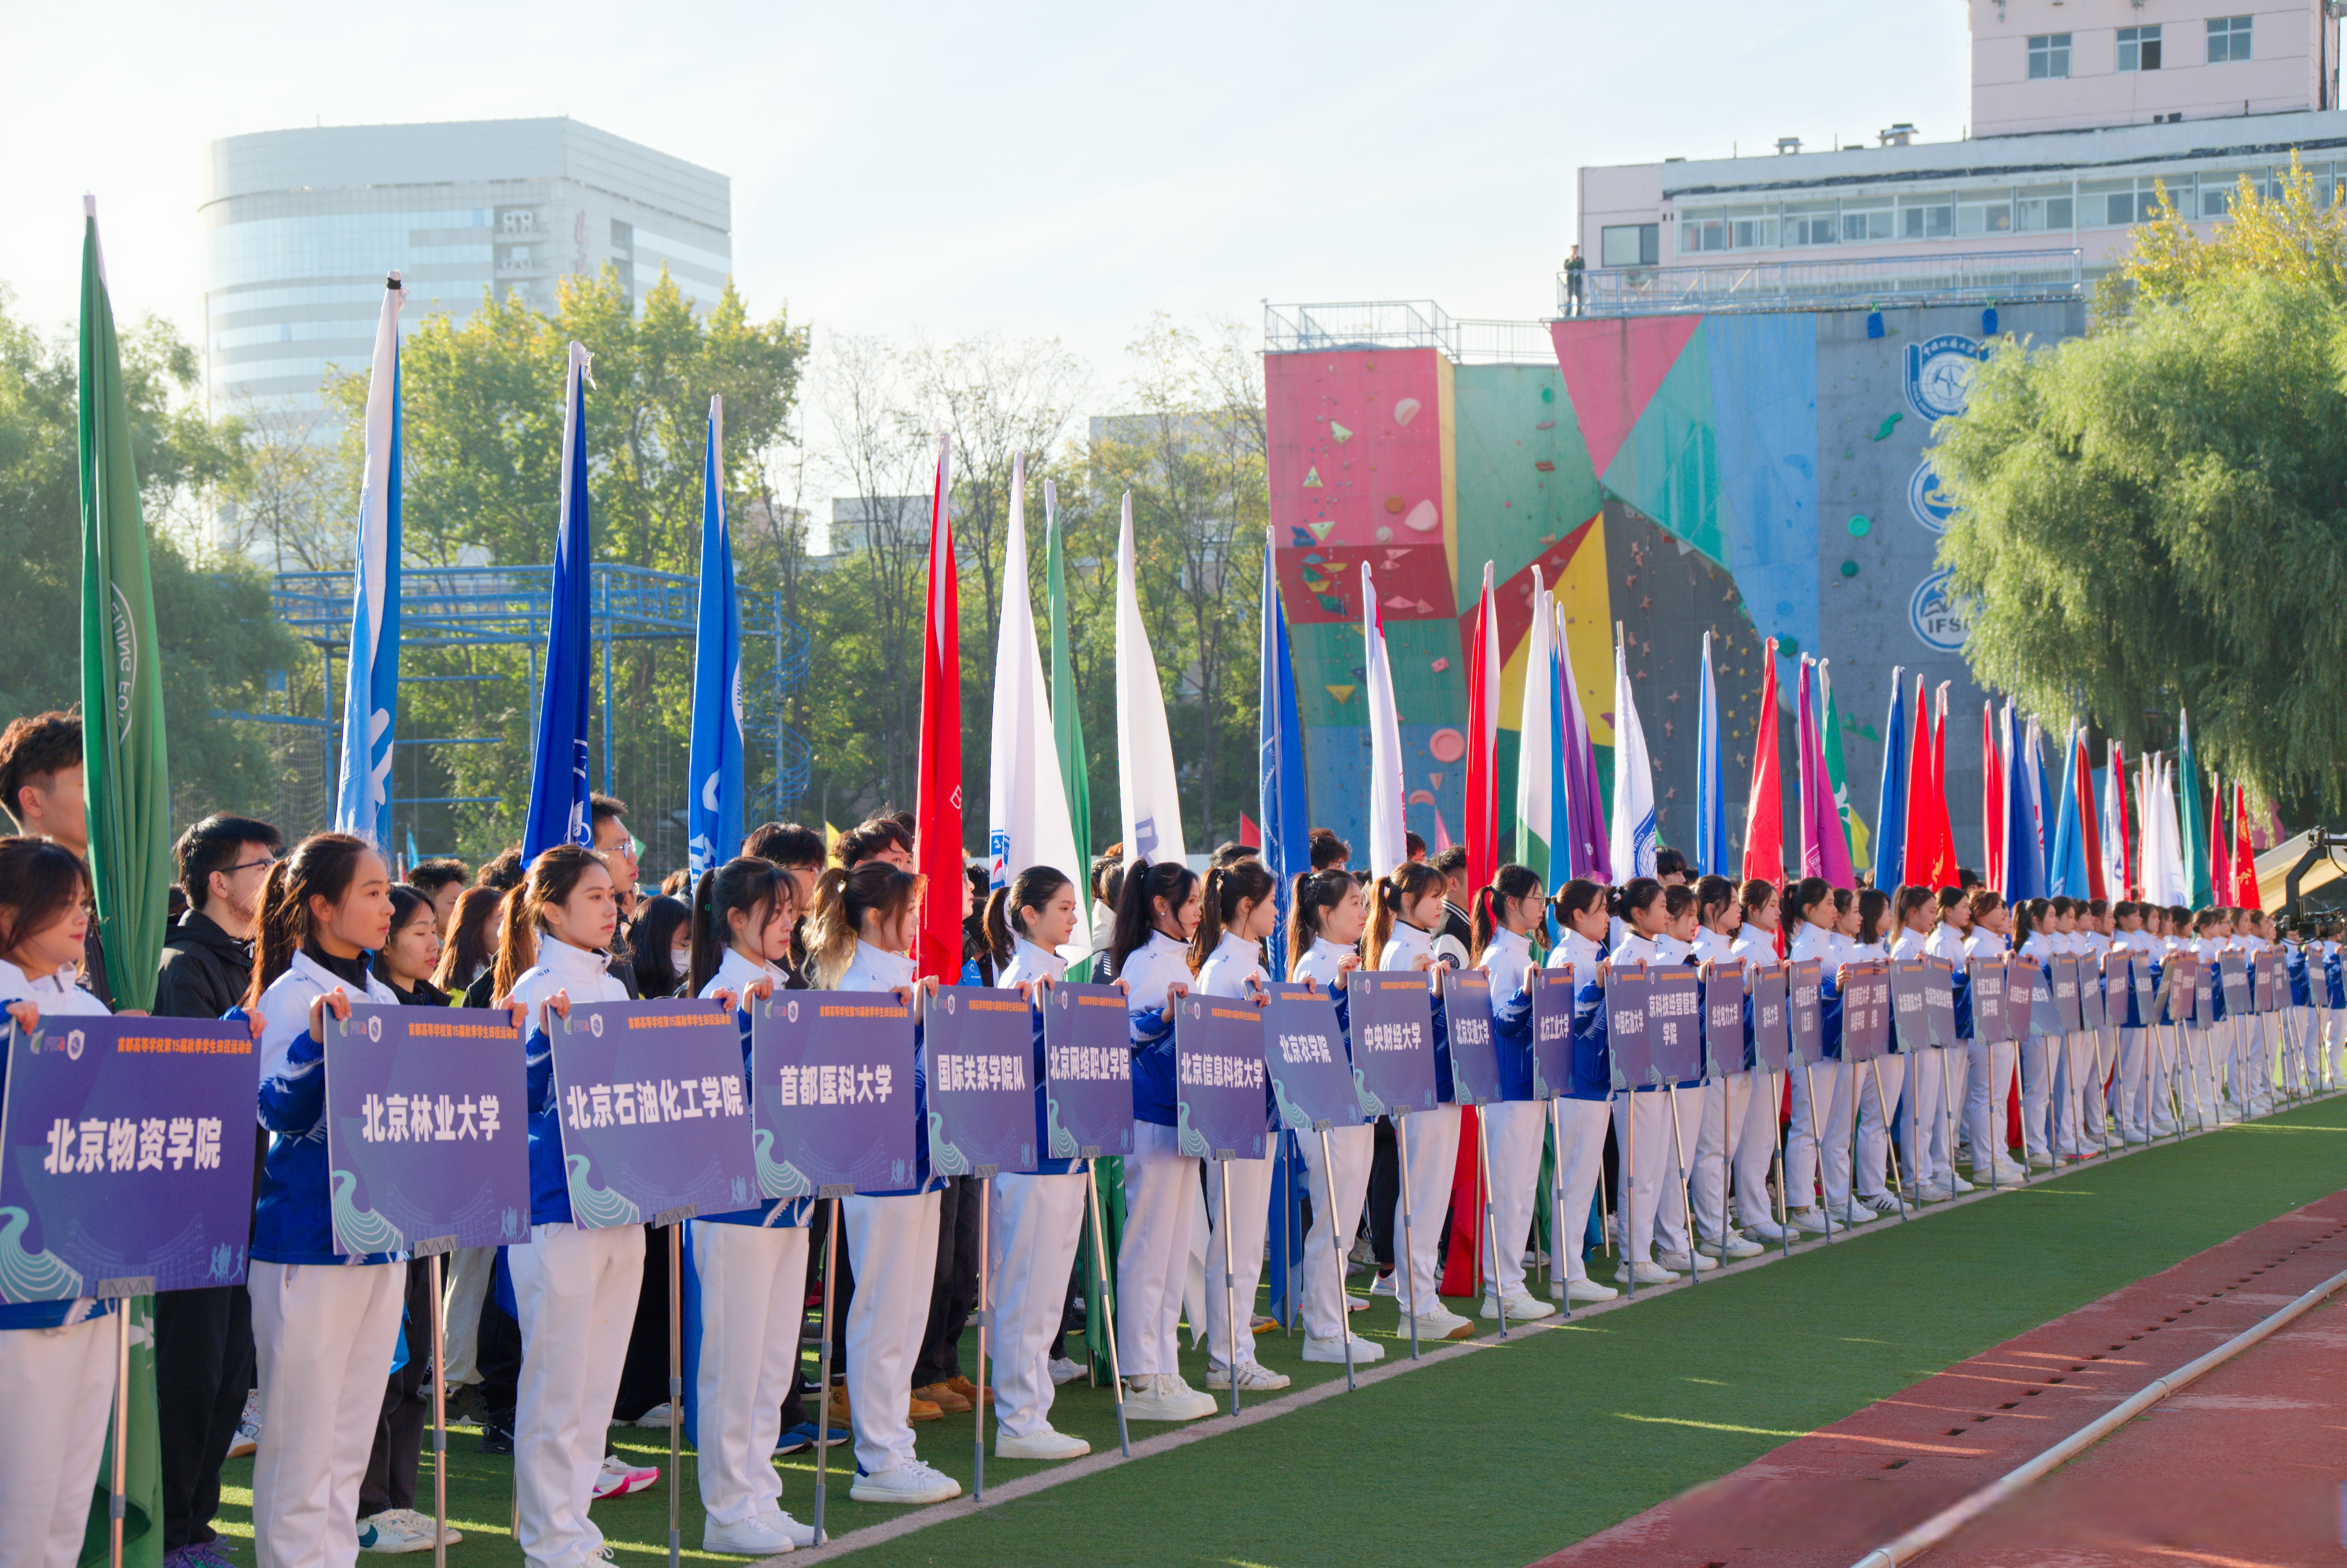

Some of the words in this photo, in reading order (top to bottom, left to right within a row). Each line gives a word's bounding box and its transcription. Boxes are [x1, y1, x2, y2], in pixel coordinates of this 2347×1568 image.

[1647, 992, 1697, 1018] 京科技经营管理
[1712, 1003, 1738, 1028] 华北电力大学
[1763, 1004, 1779, 1028] 清华大学
[408, 1022, 518, 1040] 首都高等学校第15届秋季学生田径运动会
[1455, 1019, 1490, 1045] 北京交通大学
[1540, 1013, 1569, 1042] 北方工业大学
[1614, 1009, 1644, 1036] 中国石油大学
[1662, 1022, 1678, 1046] 学院
[117, 1036, 252, 1054] 首都高等学校第15届秋季学生田径运动会
[1279, 1034, 1332, 1063] 北京农学院
[1364, 1022, 1422, 1053] 中央财经大学
[937, 1054, 1025, 1092] 国际关系学院队
[1050, 1045, 1130, 1081] 北京网络职业学院
[1181, 1052, 1263, 1089] 北京信息科技大学
[779, 1064, 893, 1106] 首都医科大学
[566, 1075, 744, 1130] 北京石油化工学院
[361, 1093, 501, 1143] 北京林业大学
[43, 1117, 222, 1175] 北京物资学院
